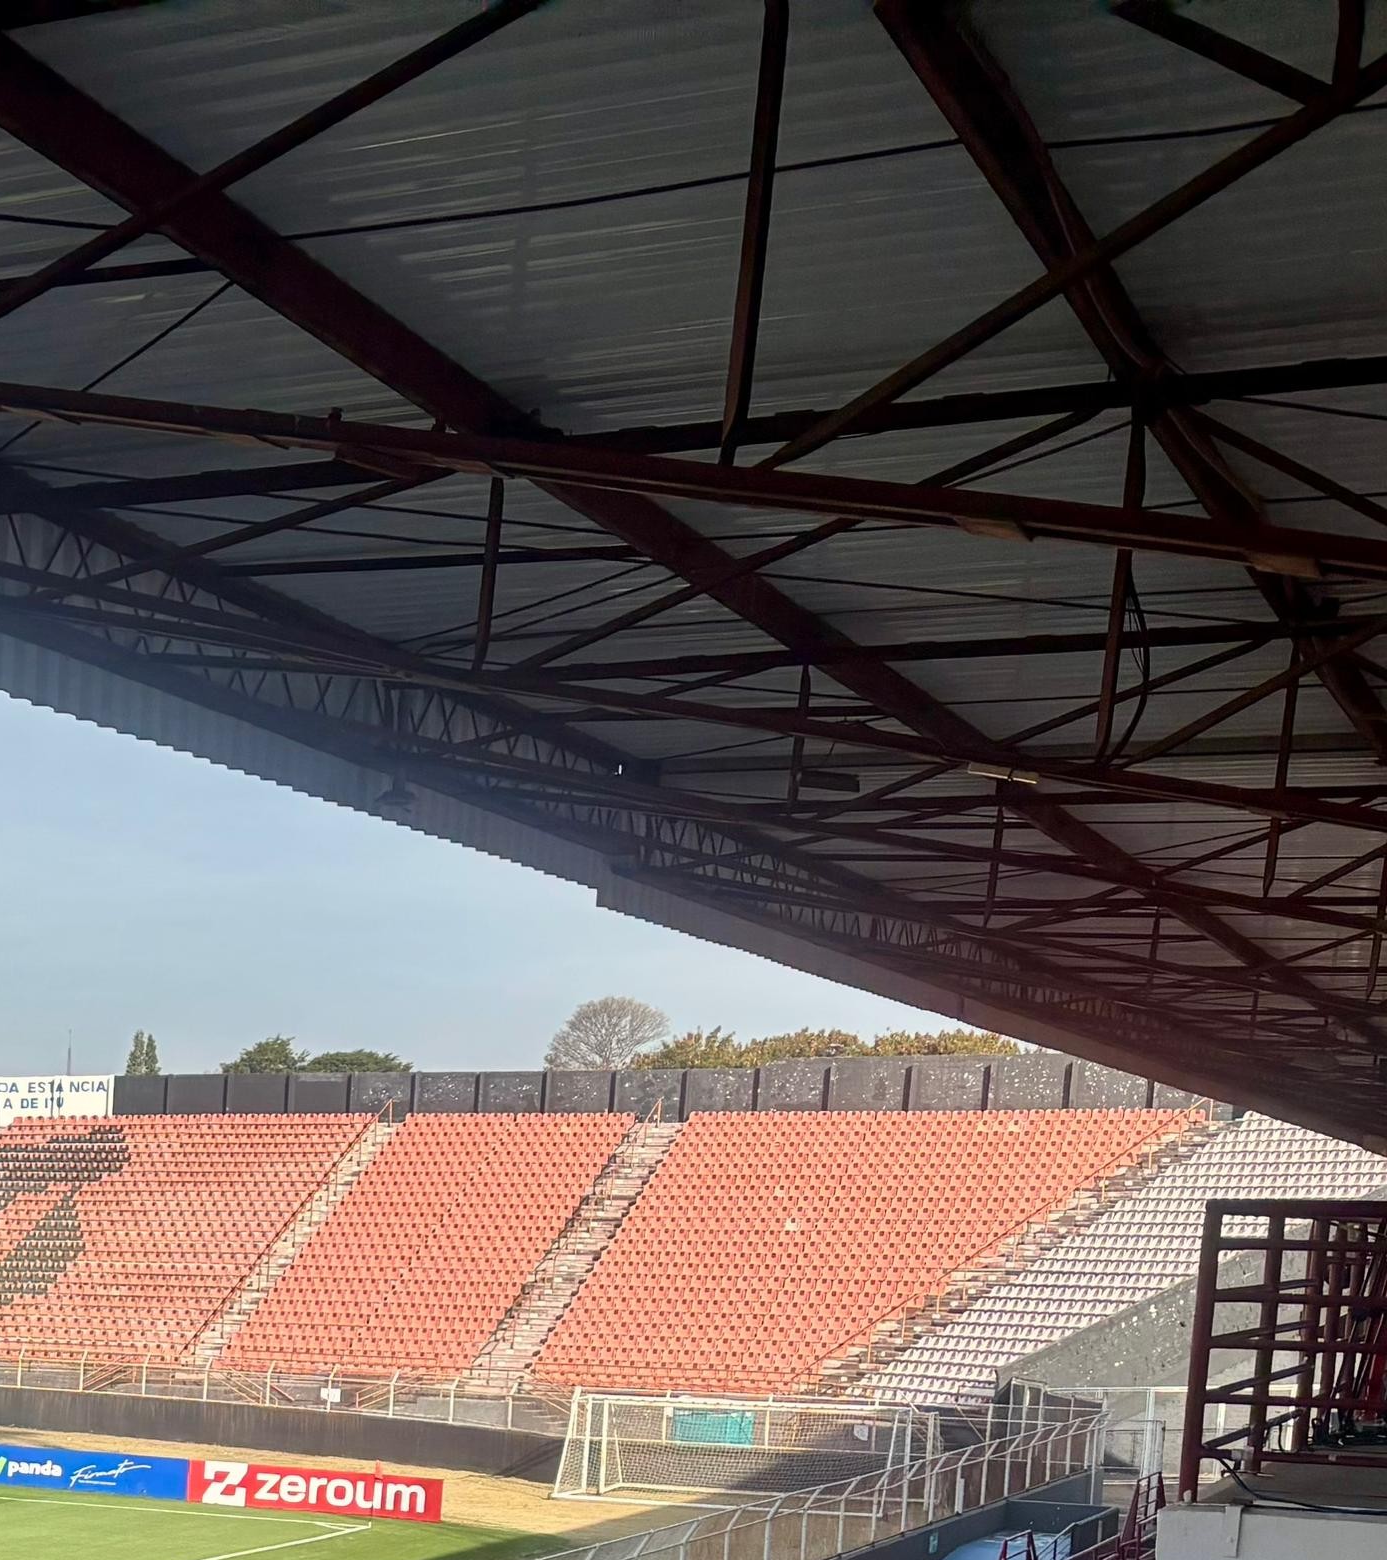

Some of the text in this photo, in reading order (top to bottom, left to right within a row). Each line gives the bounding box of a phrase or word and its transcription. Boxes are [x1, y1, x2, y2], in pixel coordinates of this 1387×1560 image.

[20, 1097, 39, 1110] DE
[7, 1459, 63, 1477] panda
[254, 1472, 426, 1514] zeroum
